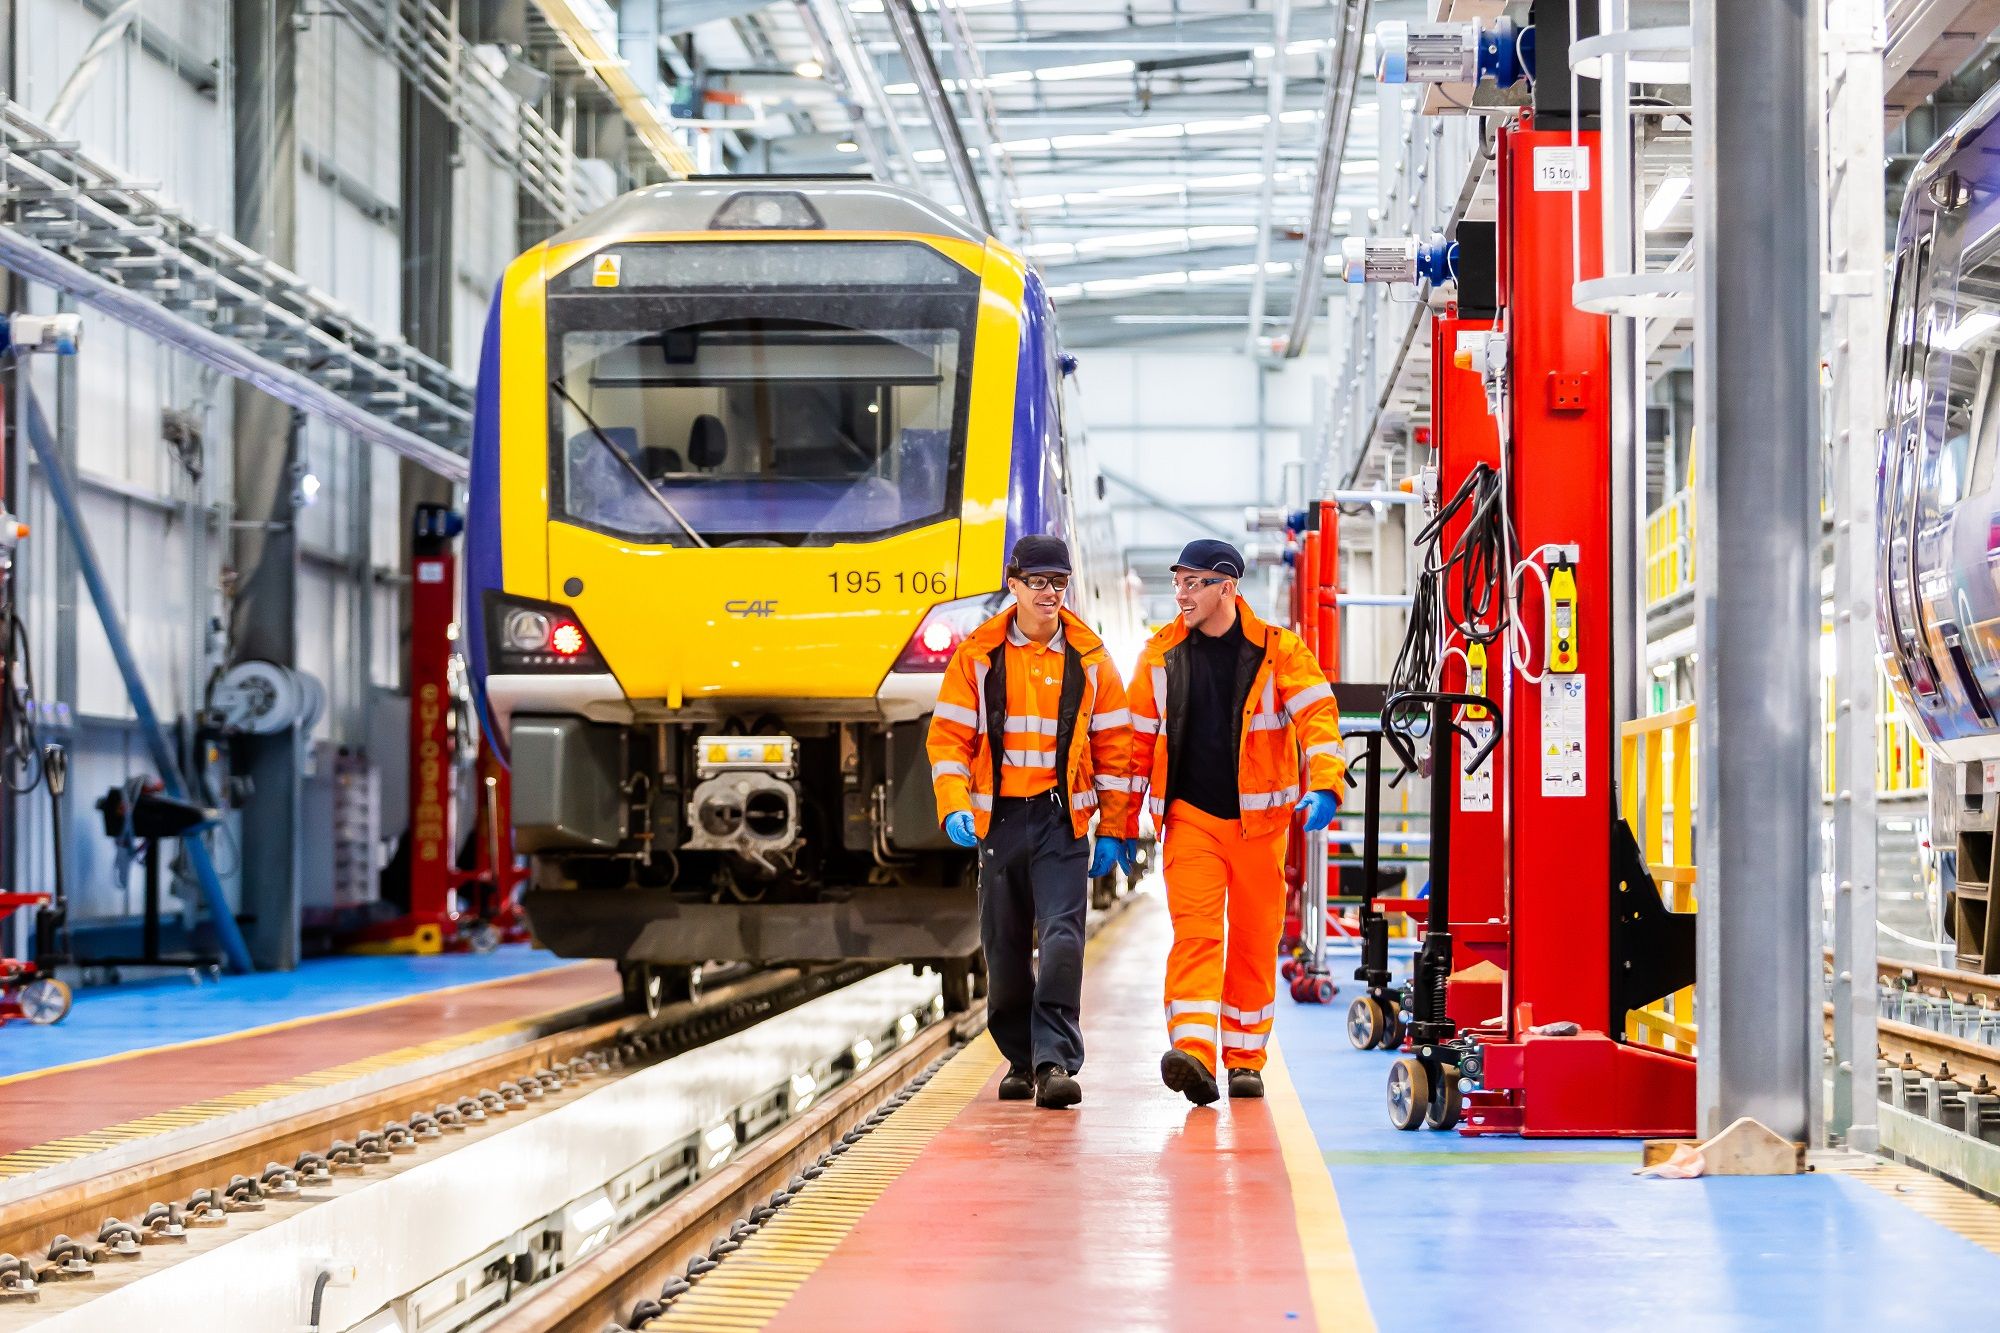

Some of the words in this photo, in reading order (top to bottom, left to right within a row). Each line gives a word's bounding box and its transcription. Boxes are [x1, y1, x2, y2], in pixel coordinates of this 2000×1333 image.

[1542, 166, 1556, 179] 15
[828, 571, 881, 594] 195
[894, 571, 947, 595] 106
[725, 600, 778, 618] CAF
